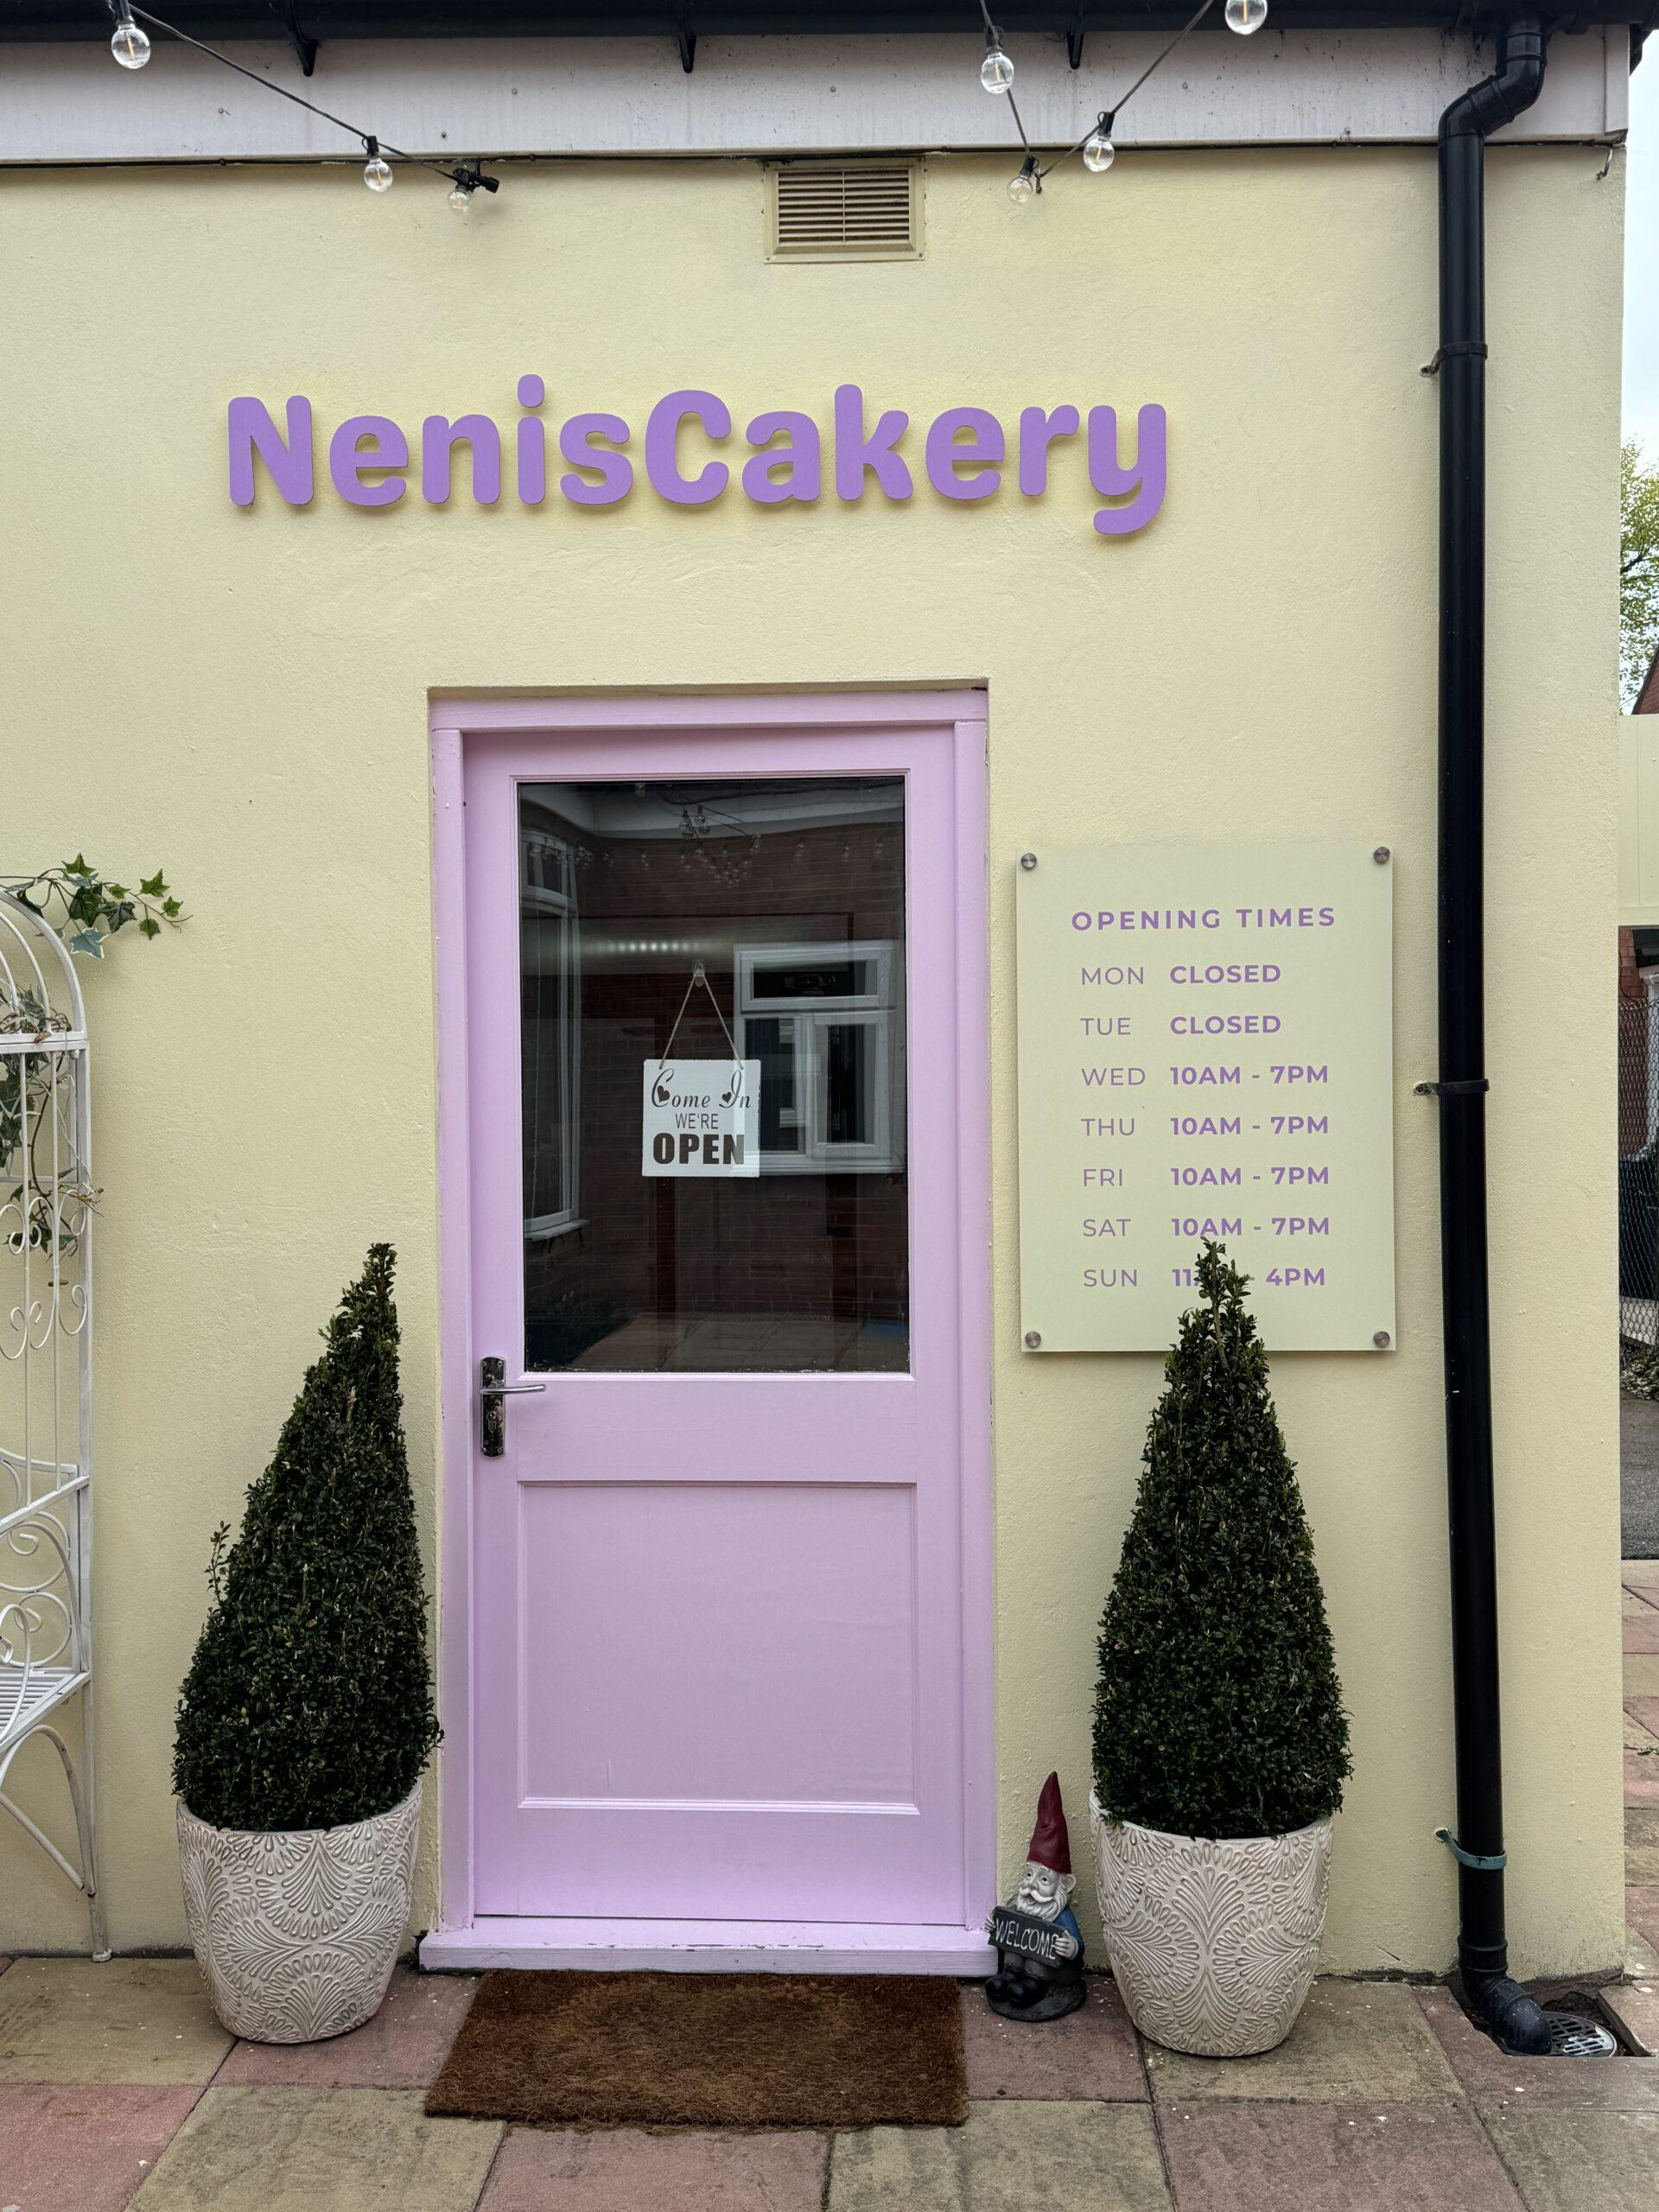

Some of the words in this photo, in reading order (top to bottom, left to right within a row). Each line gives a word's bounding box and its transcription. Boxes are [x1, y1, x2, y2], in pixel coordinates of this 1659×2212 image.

[227, 374, 1166, 535] NenisCakery
[1071, 909, 1221, 931] OPENING
[1236, 906, 1336, 928] TIMES
[1081, 967, 1145, 986] MON
[1169, 964, 1281, 985] CLOSED
[1080, 1017, 1132, 1036] TUE
[1169, 1014, 1281, 1035] CLOSED
[1081, 1067, 1146, 1086] WED
[1169, 1065, 1242, 1086] 10AM
[1269, 1065, 1329, 1084] 7PM
[651, 1068, 711, 1108] Come
[719, 1069, 751, 1108] In
[1081, 1117, 1135, 1137] THU
[1170, 1116, 1242, 1136] 10AM
[1269, 1115, 1329, 1135] 7PM
[652, 1132, 745, 1165] OPEN
[1083, 1167, 1124, 1187] FRI
[1170, 1166, 1243, 1186] 10AM
[1270, 1166, 1330, 1185] 7PM
[1083, 1218, 1131, 1237] SAT
[1171, 1217, 1243, 1236] 10AM
[1271, 1216, 1331, 1236] 7PM
[1083, 1268, 1138, 1288] SUN
[1265, 1267, 1326, 1287] 4PM
[995, 1917, 1059, 1960] WELCOME
